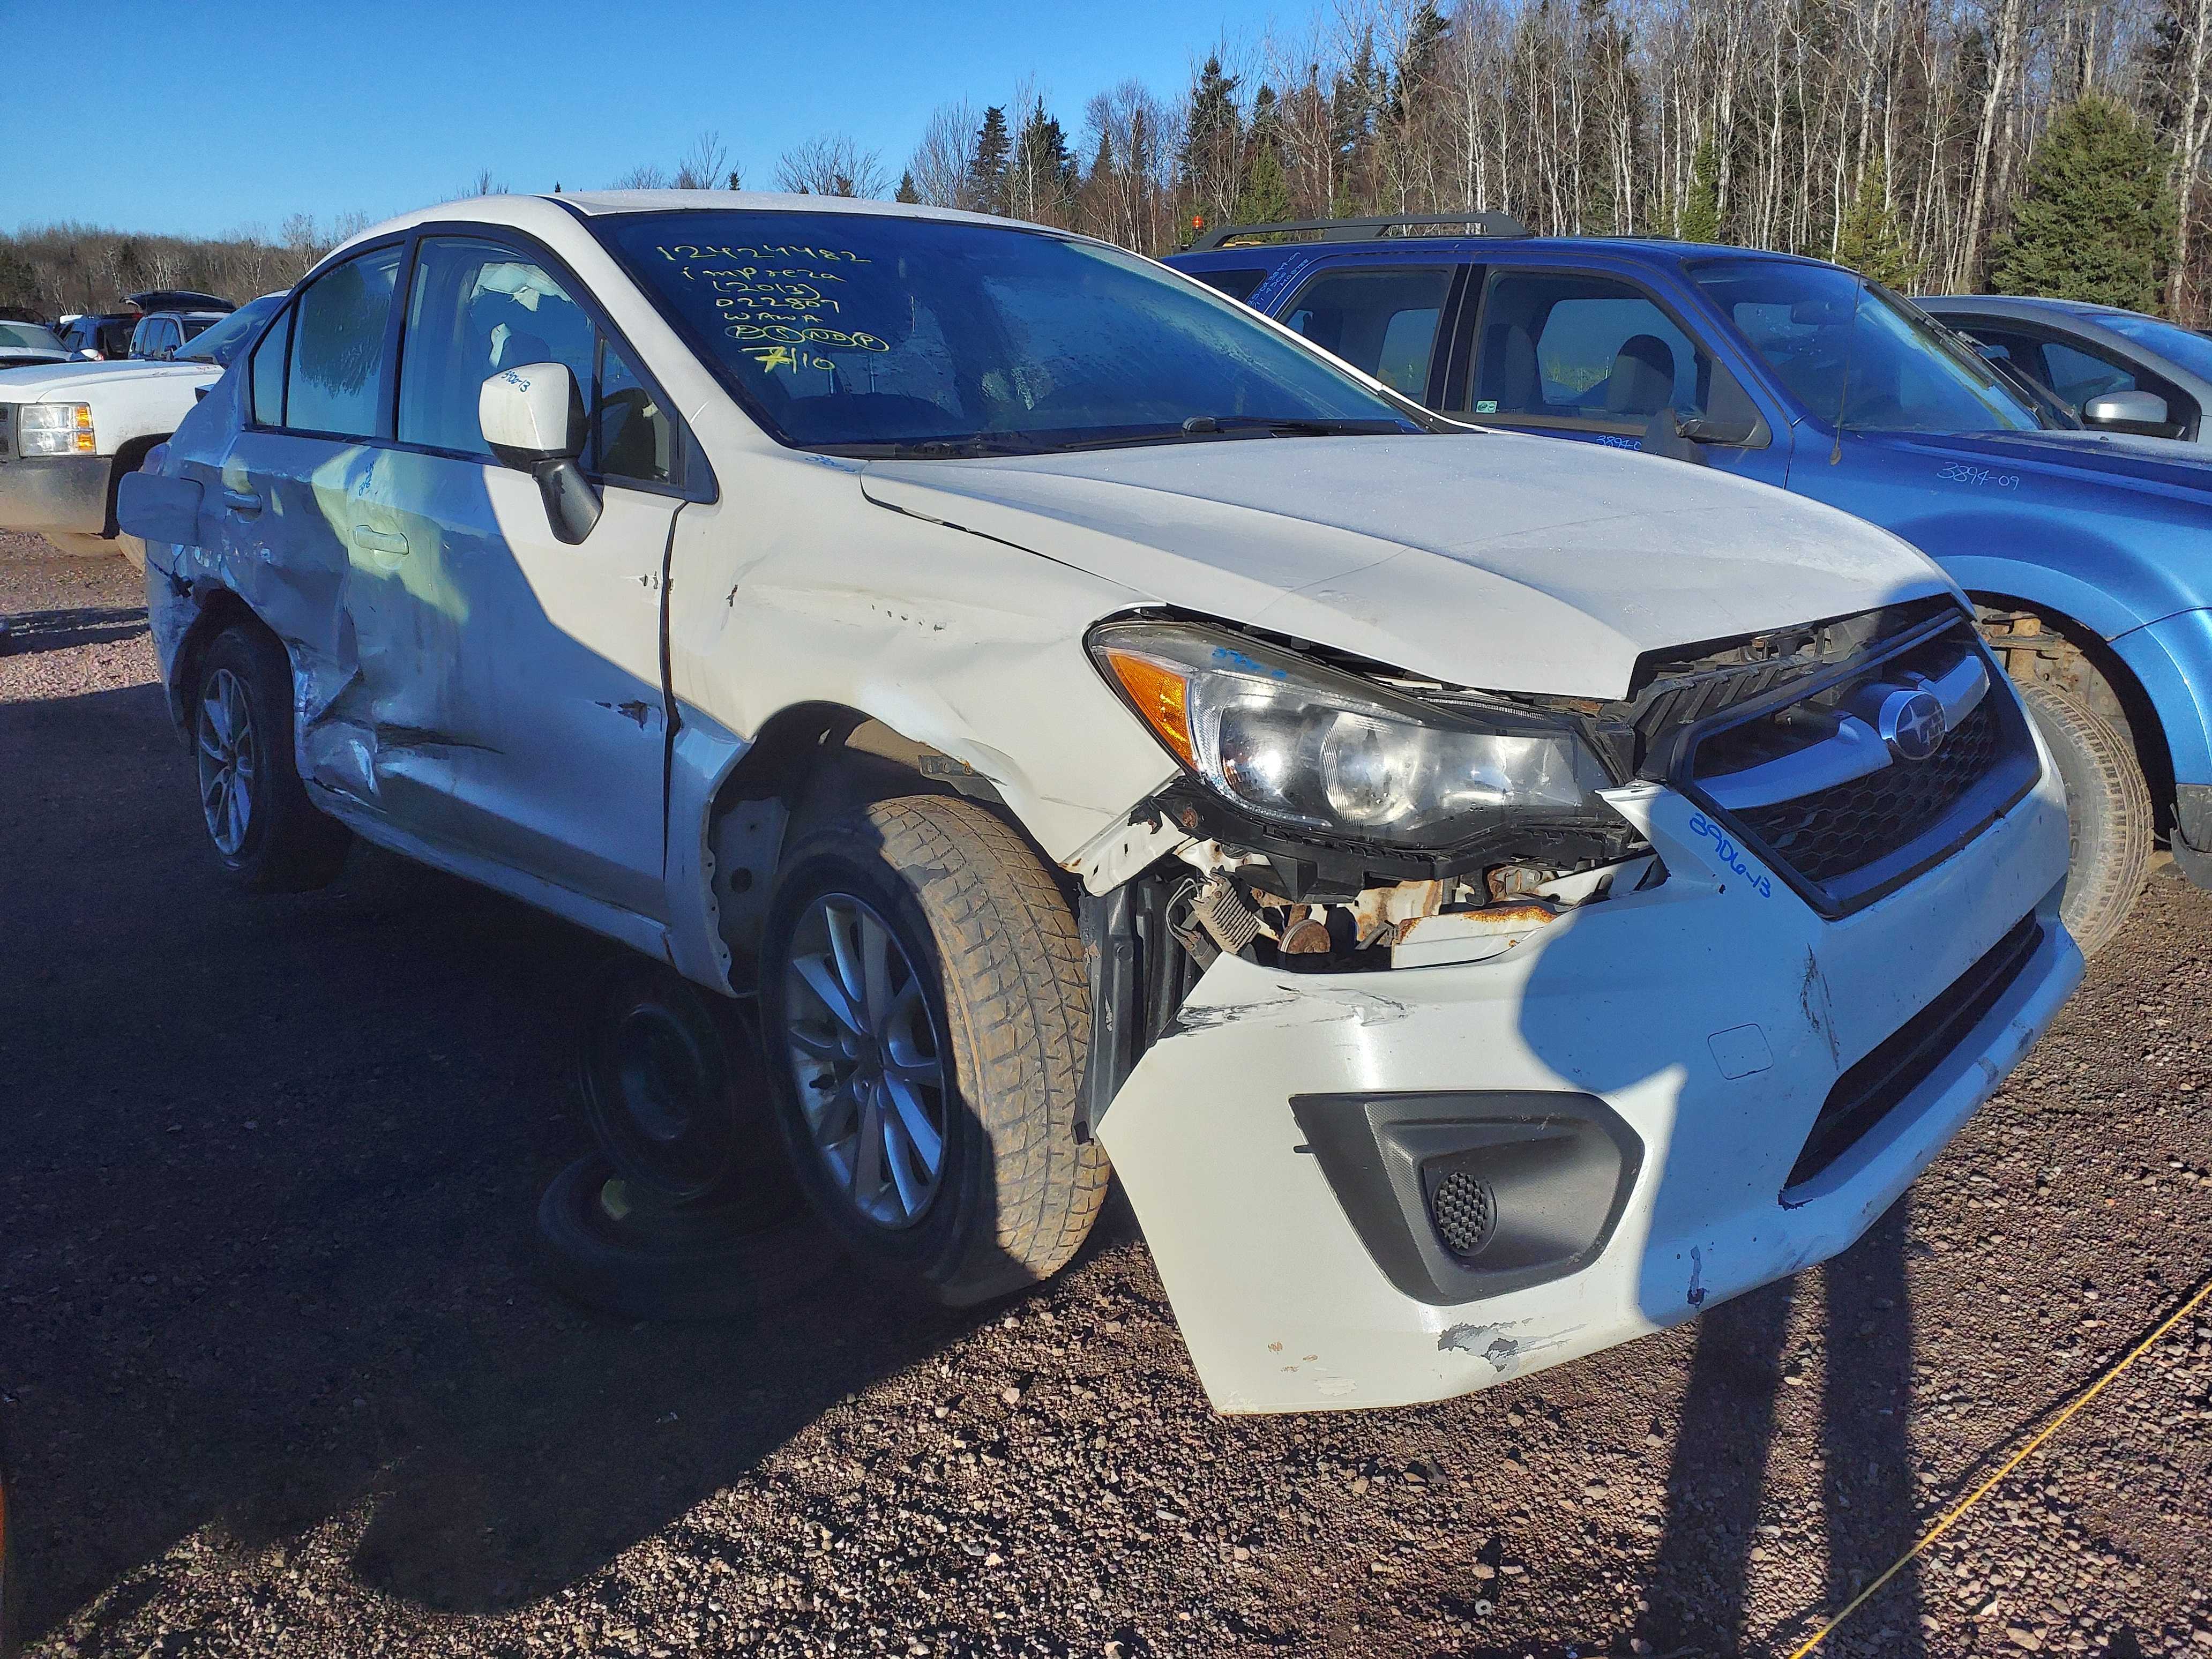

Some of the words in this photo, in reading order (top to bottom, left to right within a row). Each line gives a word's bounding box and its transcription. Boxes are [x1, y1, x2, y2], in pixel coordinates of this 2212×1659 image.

[655, 244, 872, 263] 12424482
[713, 281, 821, 300] (2013)
[1596, 435, 1642, 451] 3894-0
[1937, 461, 2020, 491] 3894-09
